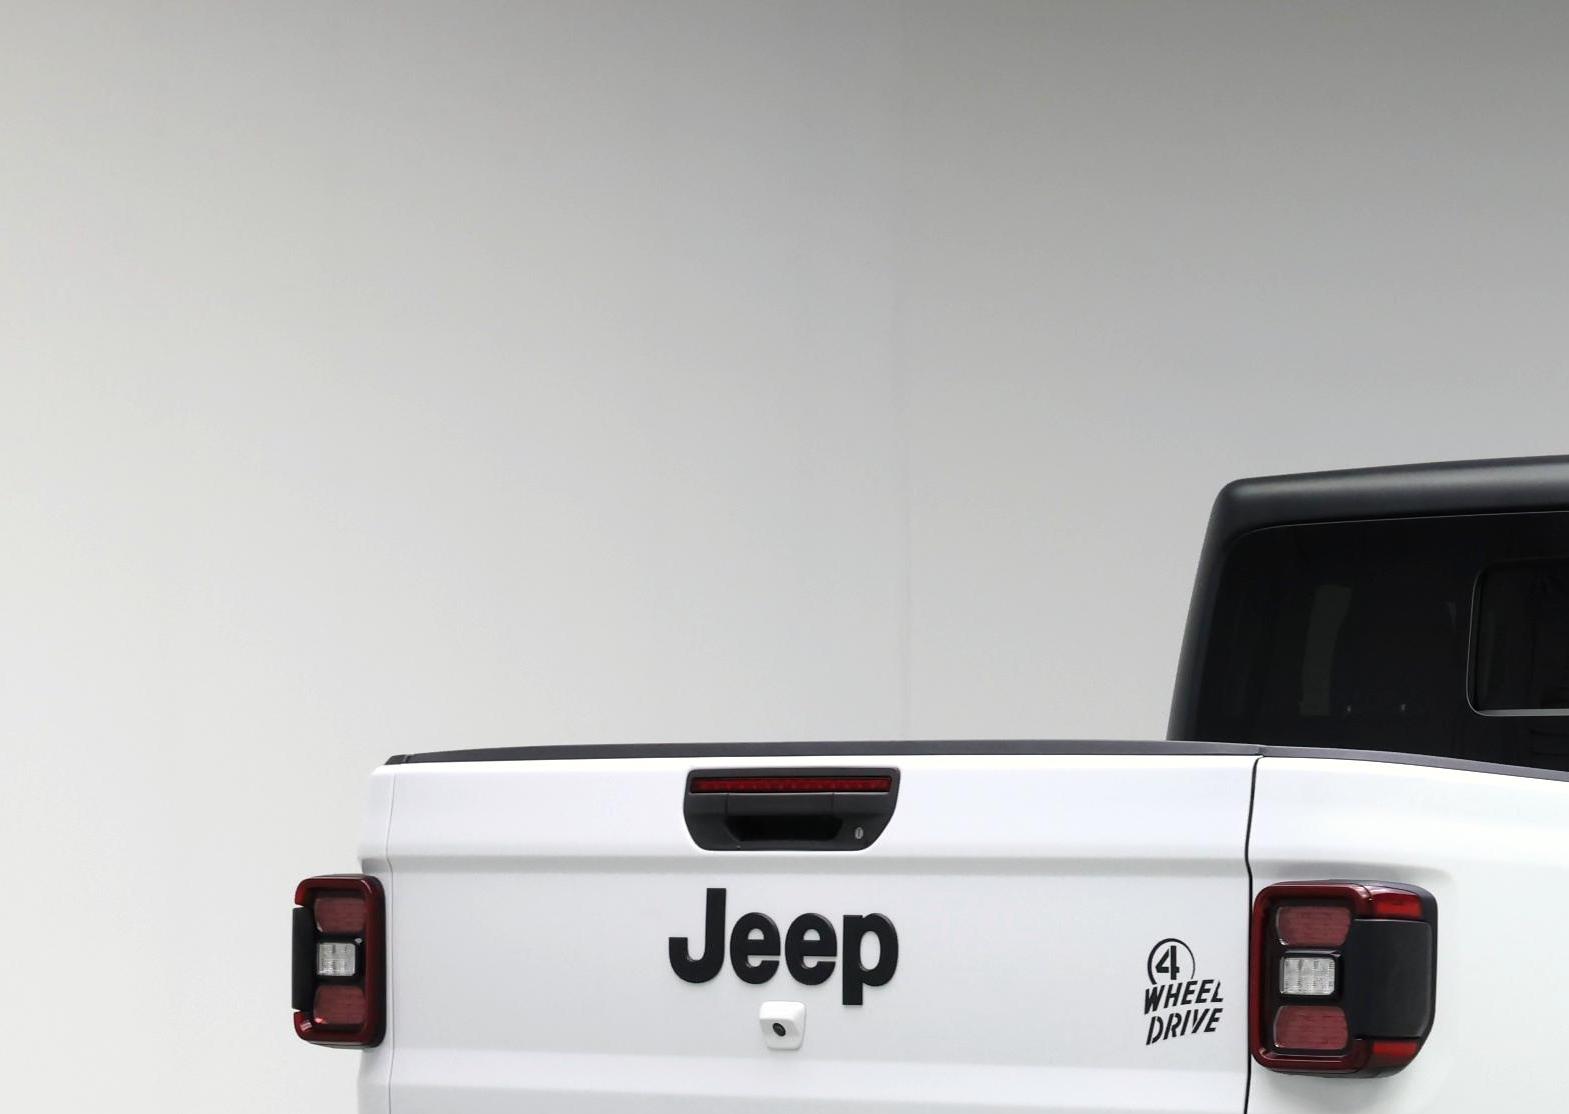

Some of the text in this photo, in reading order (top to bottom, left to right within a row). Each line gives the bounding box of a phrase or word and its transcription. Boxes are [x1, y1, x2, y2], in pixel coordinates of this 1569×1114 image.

[669, 888, 899, 1005] Jeep
[1155, 945, 1180, 981] 4
[1144, 979, 1224, 1016] WHEEL
[1145, 1007, 1224, 1046] DRIVE
